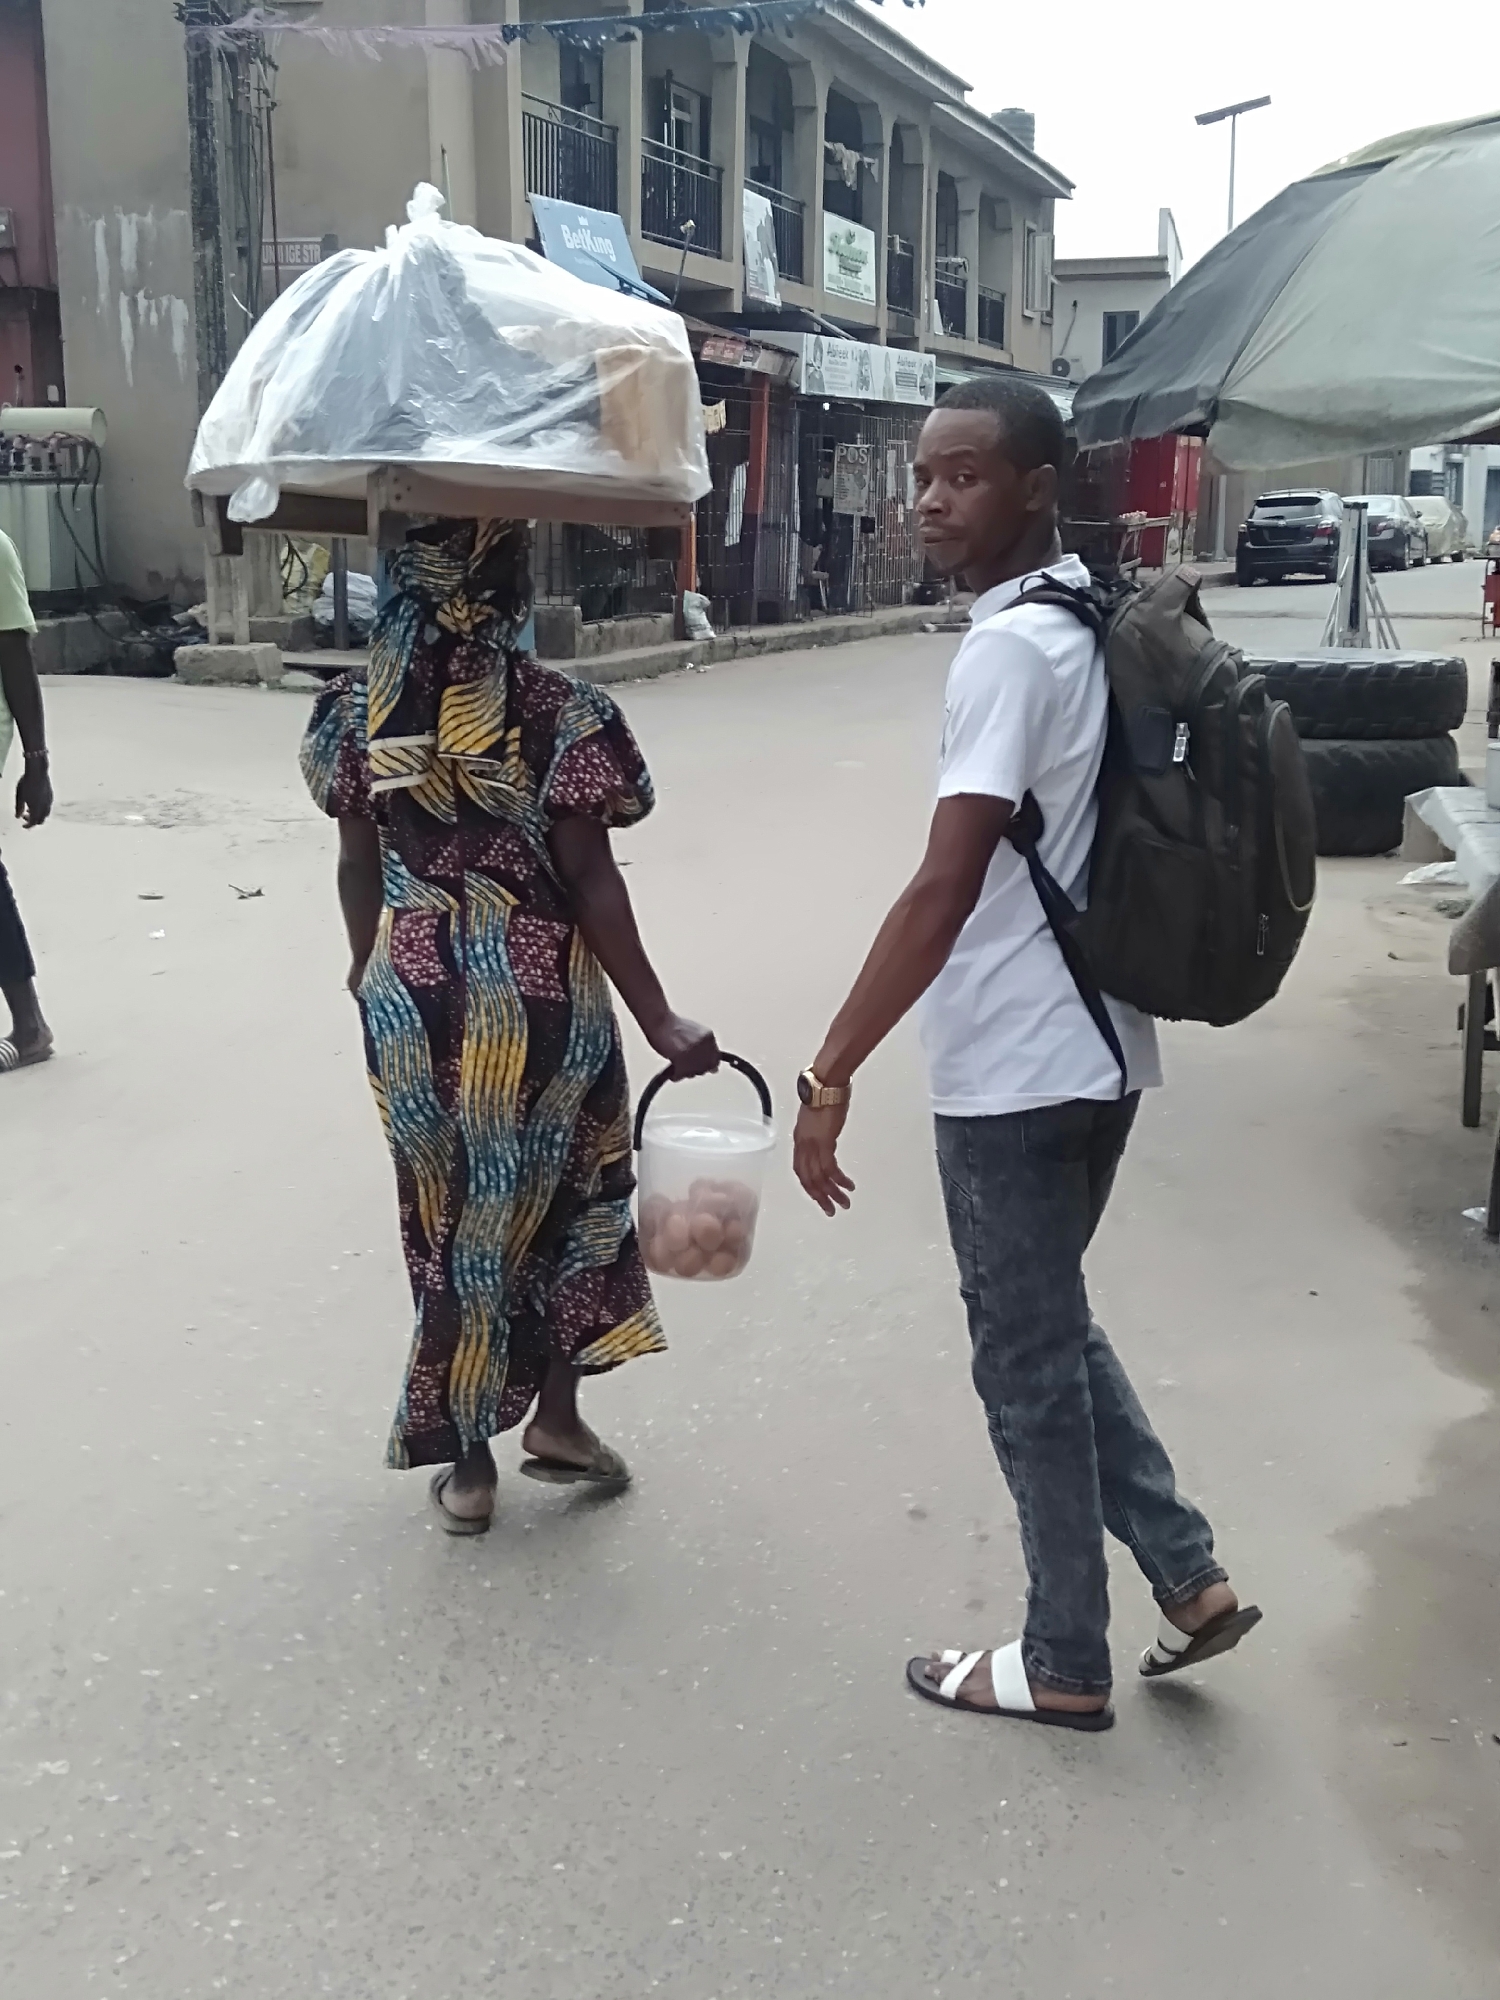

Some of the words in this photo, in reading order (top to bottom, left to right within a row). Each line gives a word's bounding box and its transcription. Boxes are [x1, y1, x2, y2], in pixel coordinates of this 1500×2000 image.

[285, 243, 301, 263] IGE
[561, 224, 616, 262] BetKing
[837, 446, 868, 464] POS
